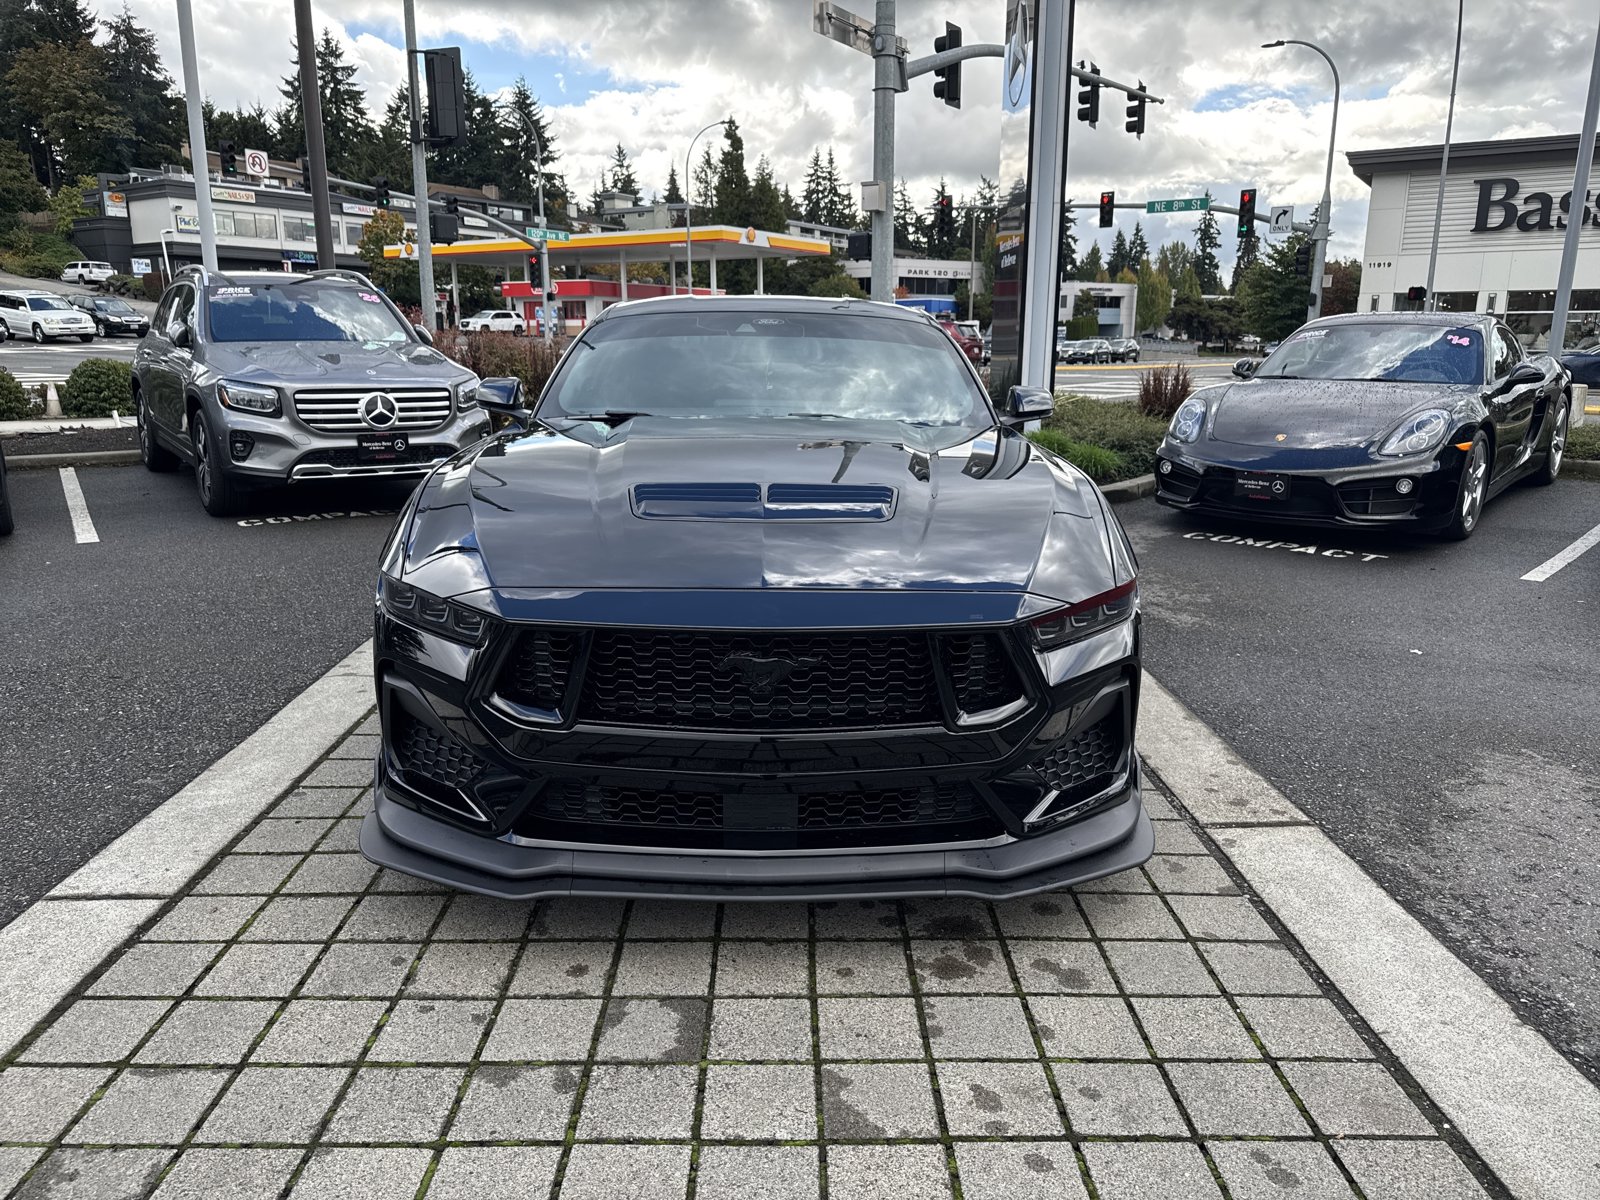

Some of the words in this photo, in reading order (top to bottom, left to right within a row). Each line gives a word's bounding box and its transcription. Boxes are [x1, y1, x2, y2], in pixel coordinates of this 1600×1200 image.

[1154, 201, 1167, 212] NE
[1172, 200, 1185, 211] 8th
[1191, 199, 1201, 210] St
[1470, 178, 1600, 233] Bas
[1272, 224, 1290, 232] ONLY
[531, 230, 544, 238] 120th
[546, 231, 557, 239] Ave
[558, 232, 566, 240] NE
[1368, 261, 1392, 269] 11919
[1237, 478, 1270, 486] Mercedes-Benz
[236, 508, 400, 527] COMPAC
[1182, 531, 1389, 562] COMPACT
